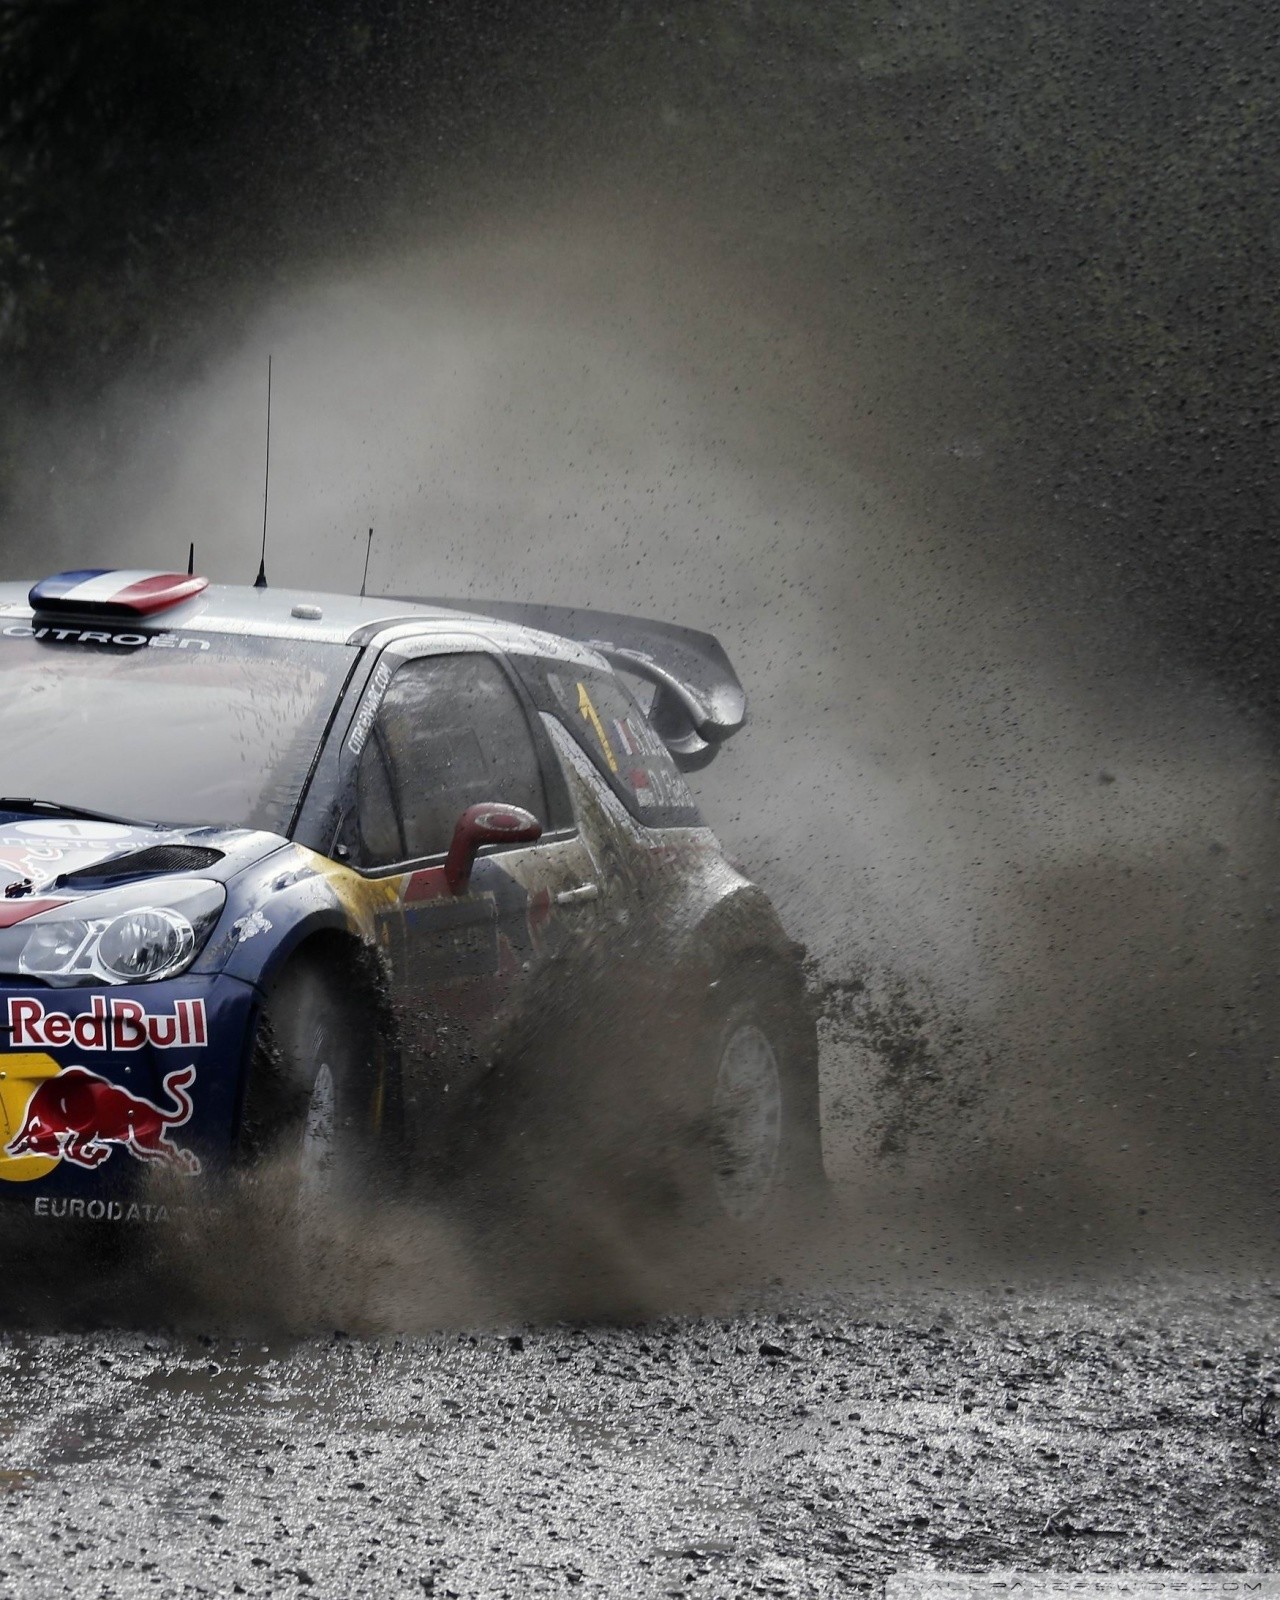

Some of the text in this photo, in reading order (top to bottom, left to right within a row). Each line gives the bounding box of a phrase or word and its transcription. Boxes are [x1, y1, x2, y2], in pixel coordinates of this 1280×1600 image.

[8, 996, 207, 1050] Red Bull
[34, 1197, 220, 1223] EURODATA
